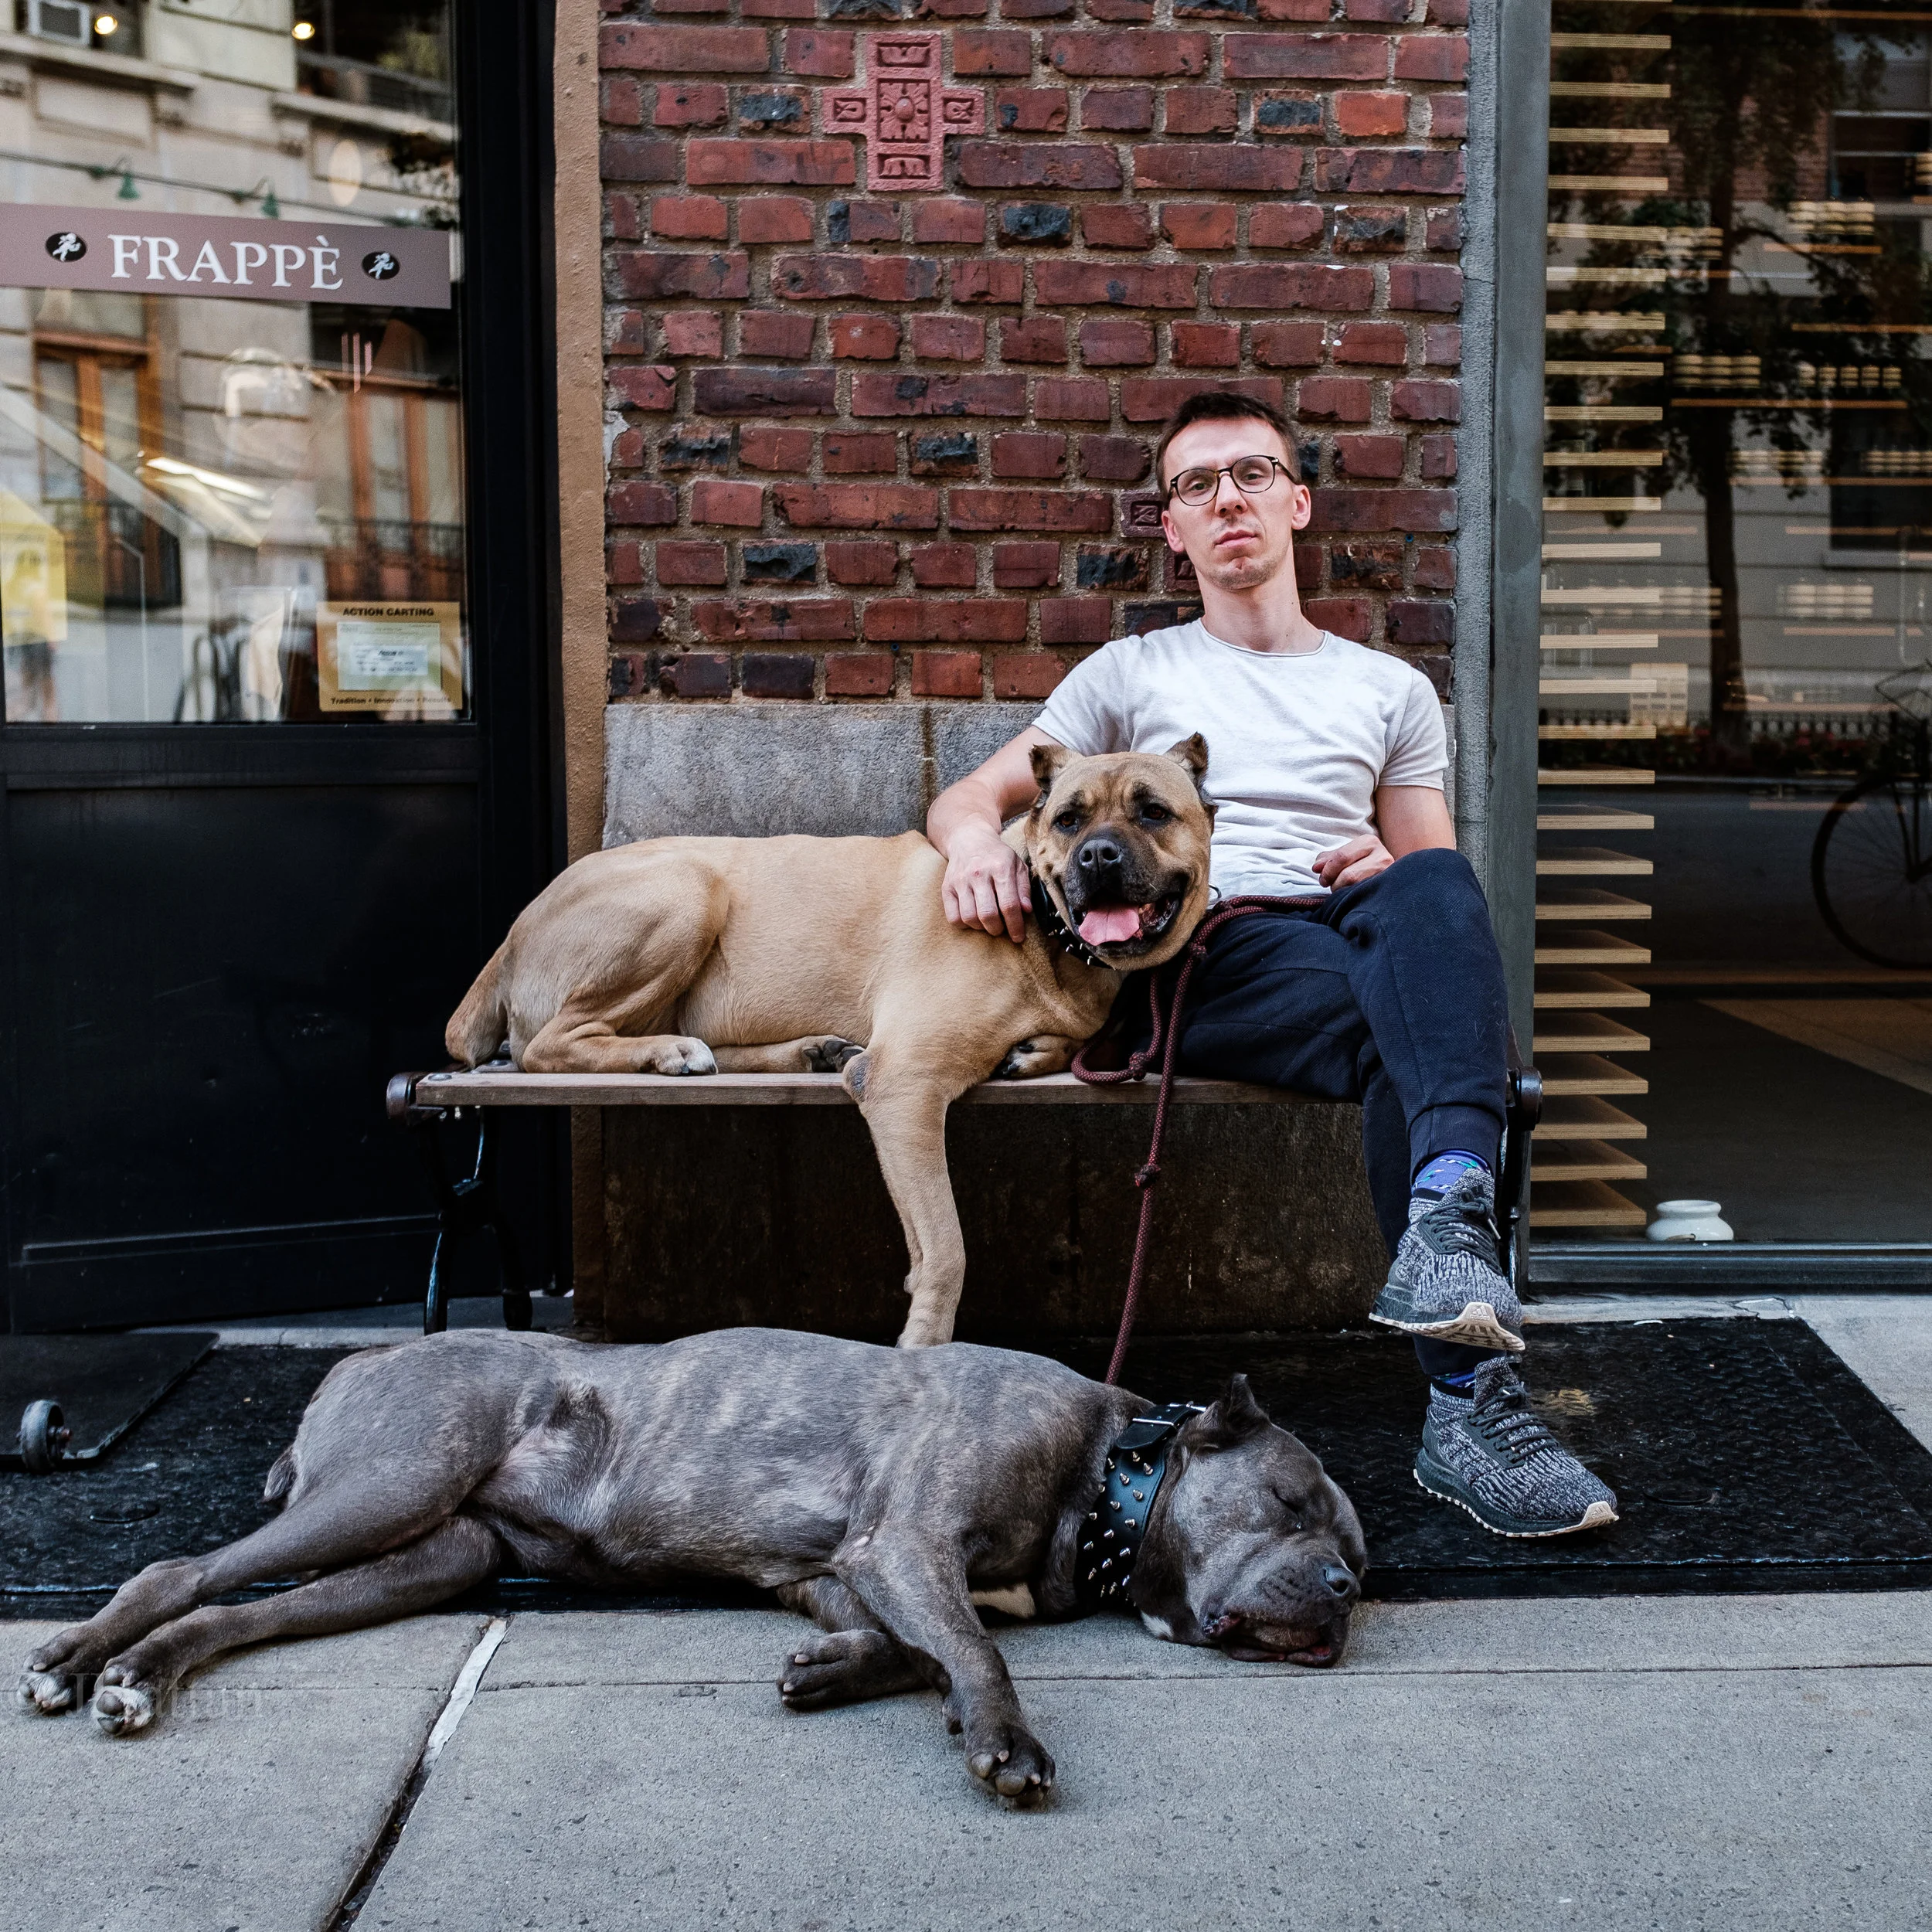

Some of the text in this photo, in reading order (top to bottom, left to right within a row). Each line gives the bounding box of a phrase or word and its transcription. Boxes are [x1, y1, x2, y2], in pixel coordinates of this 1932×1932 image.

[107, 233, 344, 291] FRAPPÈ
[342, 607, 434, 617] ACTION CARTING
